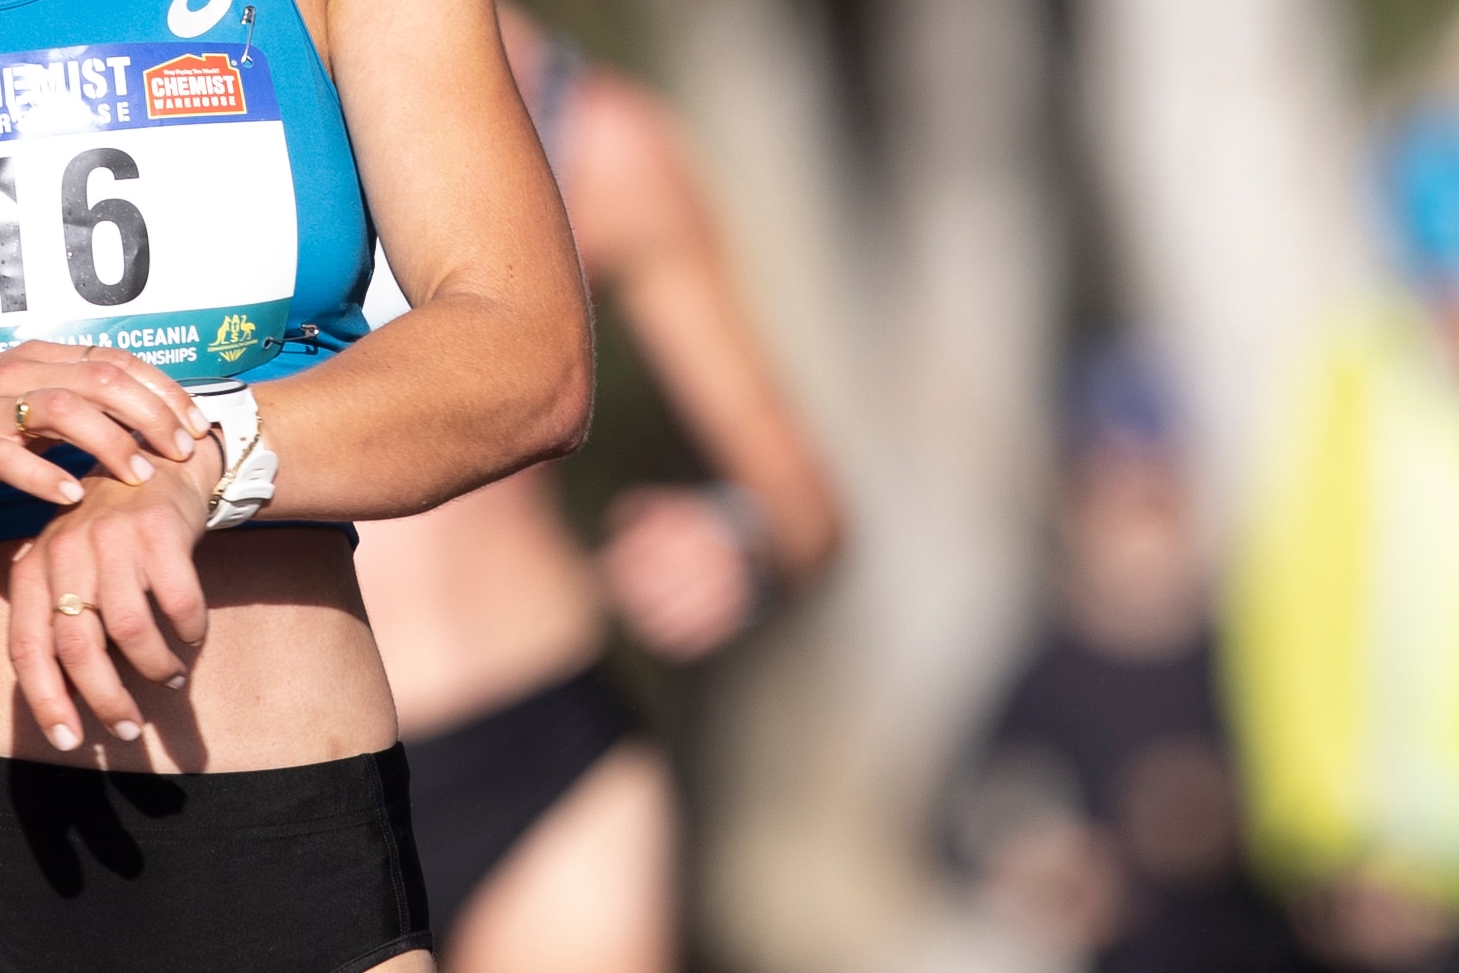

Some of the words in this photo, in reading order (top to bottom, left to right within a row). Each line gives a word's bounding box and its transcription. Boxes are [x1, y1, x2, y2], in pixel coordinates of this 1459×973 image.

[151, 75, 235, 97] CHEMIST
[153, 95, 237, 110] WAREHOUSE
[98, 332, 113, 348] &
[117, 325, 200, 349] OCEANIA
